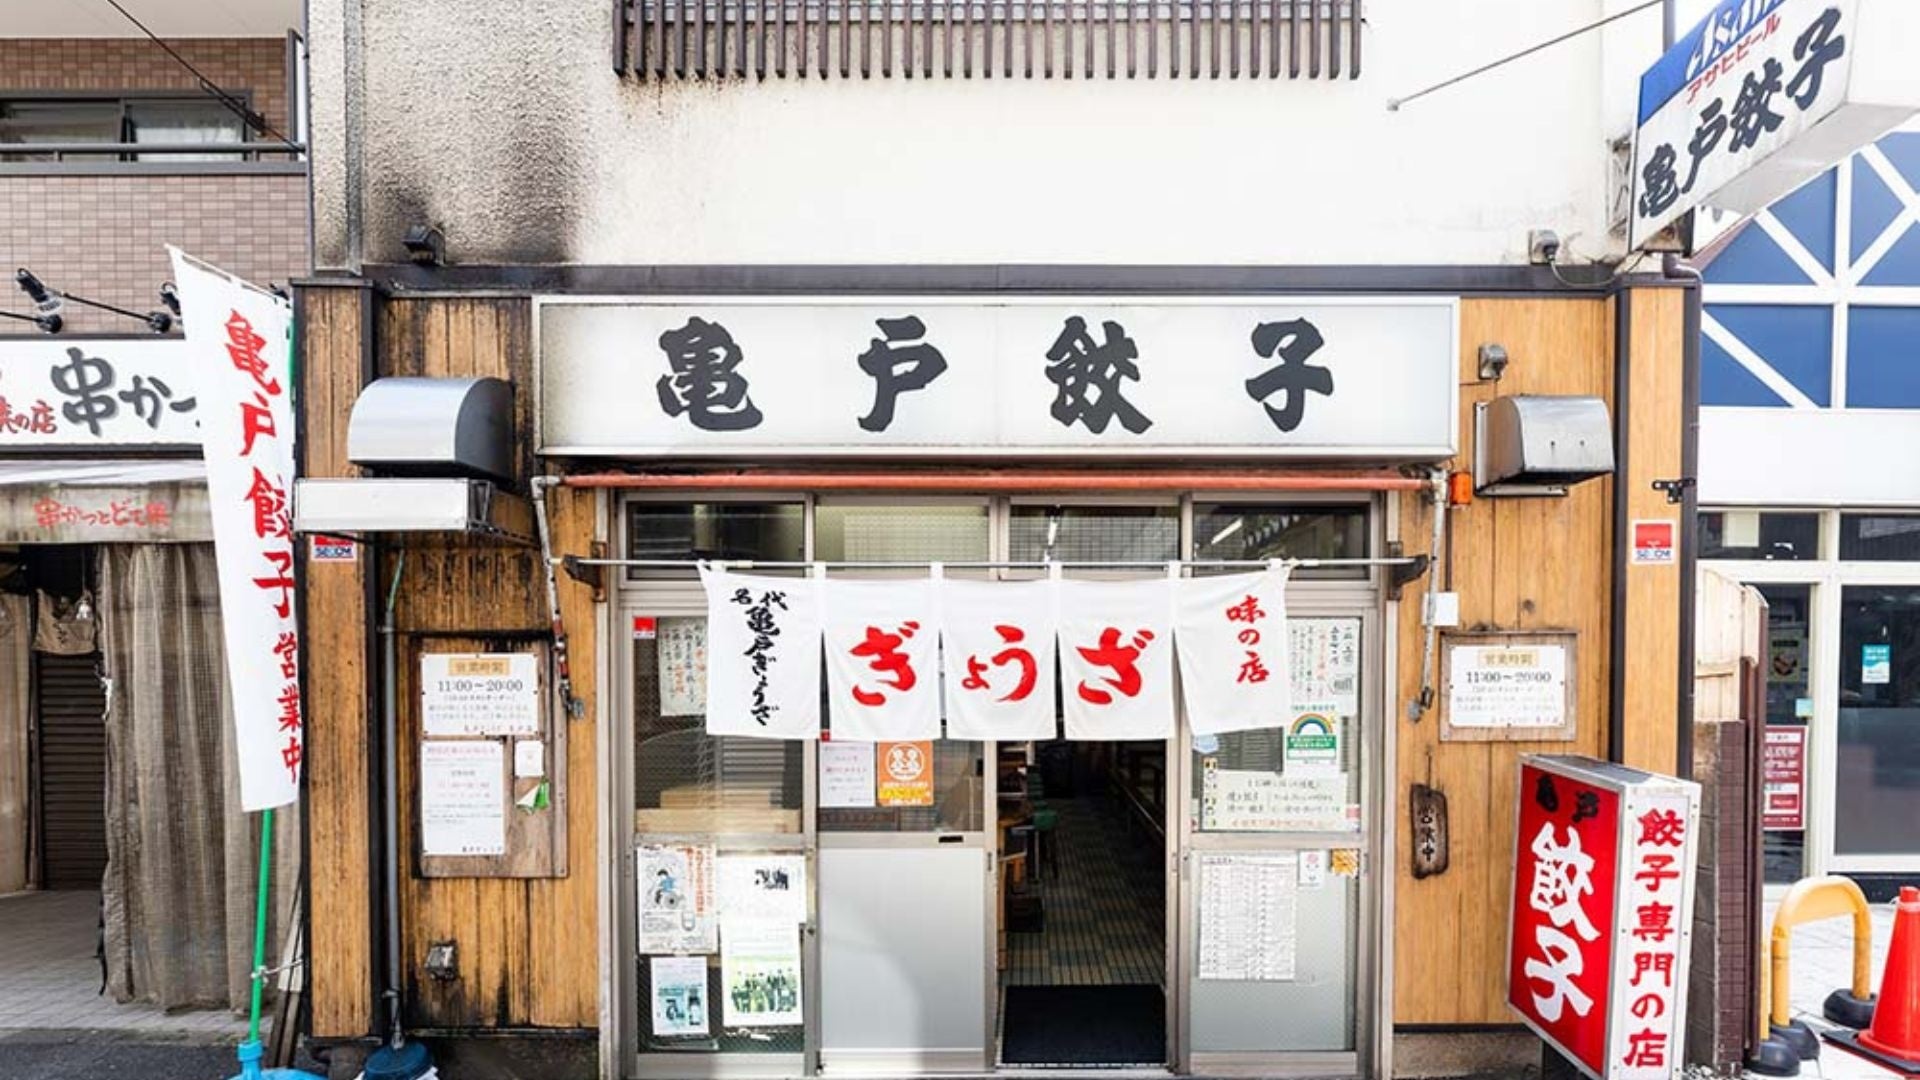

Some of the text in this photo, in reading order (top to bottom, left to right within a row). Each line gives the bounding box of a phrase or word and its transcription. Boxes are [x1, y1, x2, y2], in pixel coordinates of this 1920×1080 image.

[1639, 8, 1845, 218] 亀戸餃子
[1686, 13, 1781, 104] アサヒビール
[656, 315, 1334, 434] 亀戸餃子
[848, 620, 1156, 707] ぎょうざ
[1226, 595, 1270, 684] 味の店
[1524, 821, 1602, 1023] 餃子
[1623, 807, 1686, 1068] 餃子専門の店
